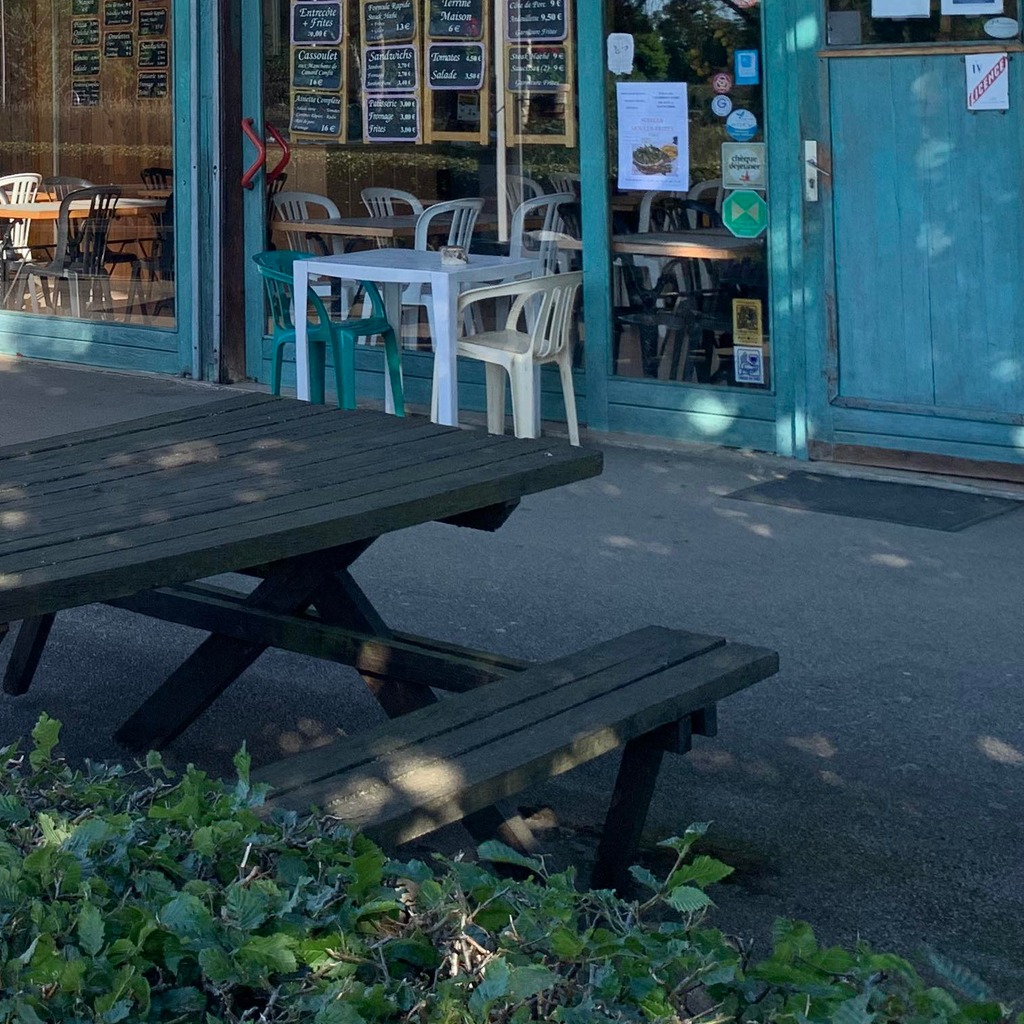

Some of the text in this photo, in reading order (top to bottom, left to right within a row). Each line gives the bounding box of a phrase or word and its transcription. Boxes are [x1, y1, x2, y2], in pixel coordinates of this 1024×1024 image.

[550, 0, 555, 7] 9
[556, 0, 562, 7] €
[299, 7, 337, 18] Entrecôte
[440, 10, 472, 21] Maison
[557, 13, 563, 21] €
[309, 17, 333, 29] Frites
[396, 22, 411, 31] 13 €
[448, 24, 461, 33] 6 €
[298, 49, 338, 61] Cassoulet
[368, 49, 413, 62] Sandwichs
[431, 52, 460, 62] Tomates
[553, 52, 558, 60] 9
[558, 52, 564, 60] €
[431, 69, 457, 81] Salade
[970, 57, 1007, 104] LICENCE
[716, 98, 727, 109] G
[368, 112, 394, 123] Fromage
[321, 124, 328, 132] 16
[368, 124, 386, 134] Frites
